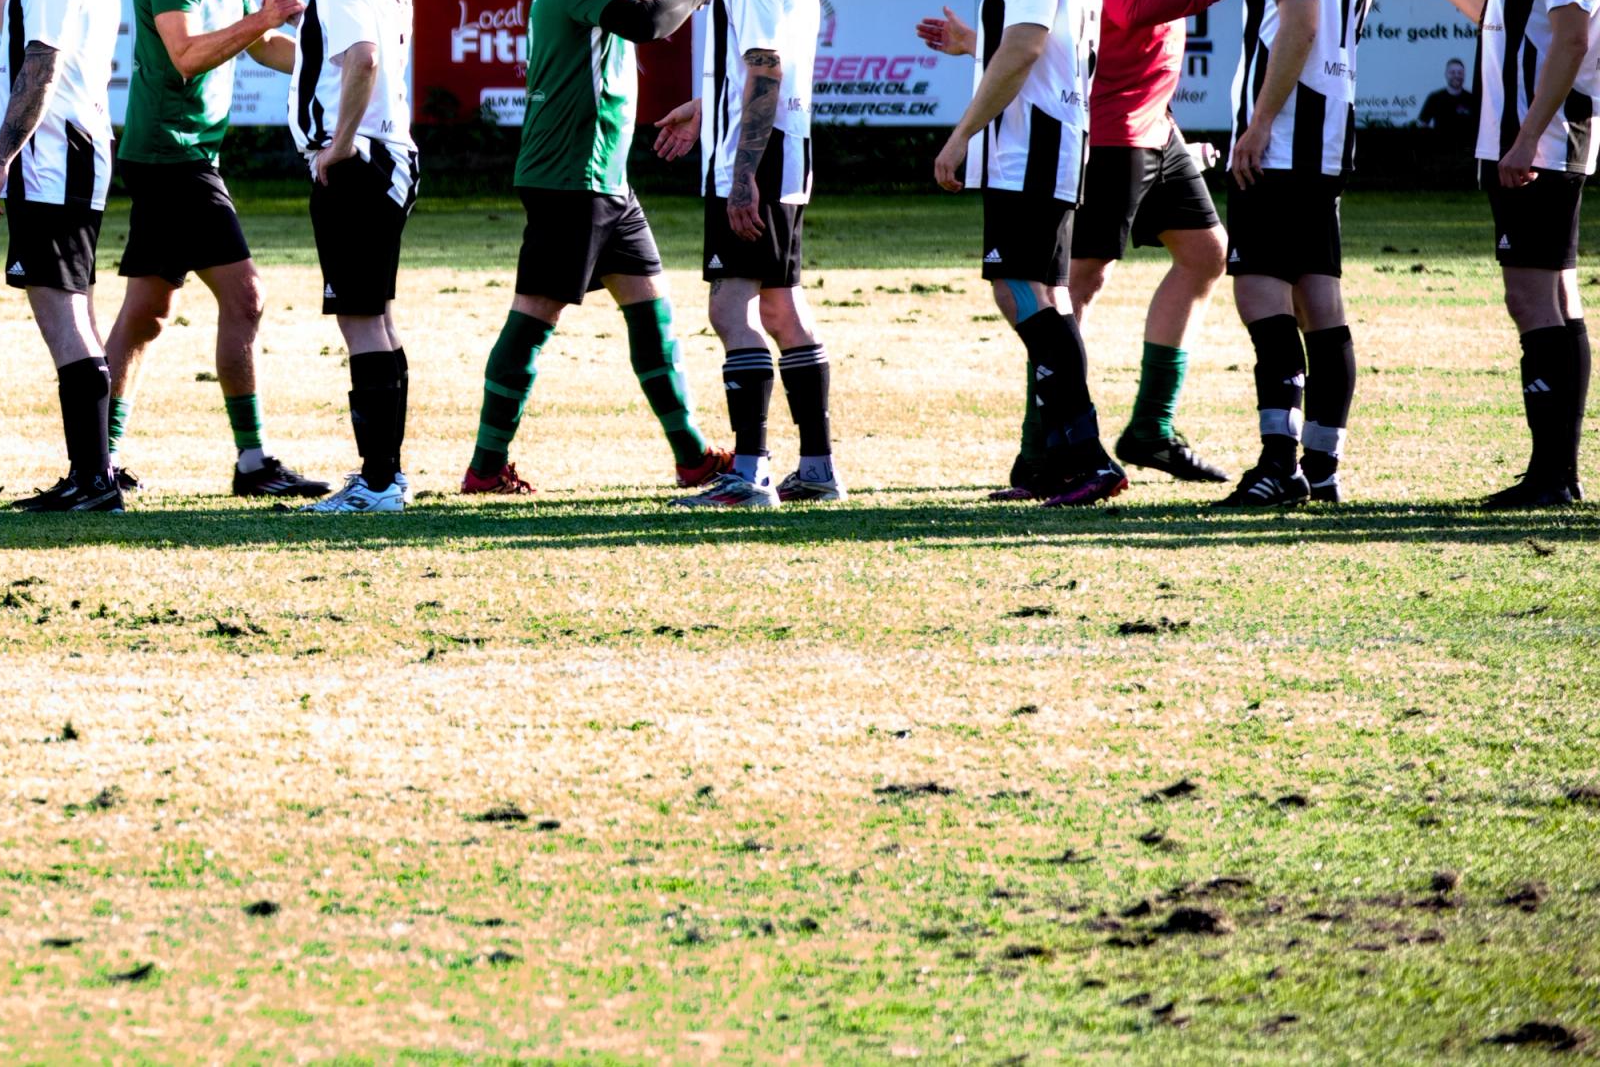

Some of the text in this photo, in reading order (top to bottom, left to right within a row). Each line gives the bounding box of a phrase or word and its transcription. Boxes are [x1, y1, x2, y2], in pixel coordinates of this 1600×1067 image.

[459, 0, 524, 31] Local
[1377, 24, 1401, 40] for
[1407, 23, 1448, 42] godt
